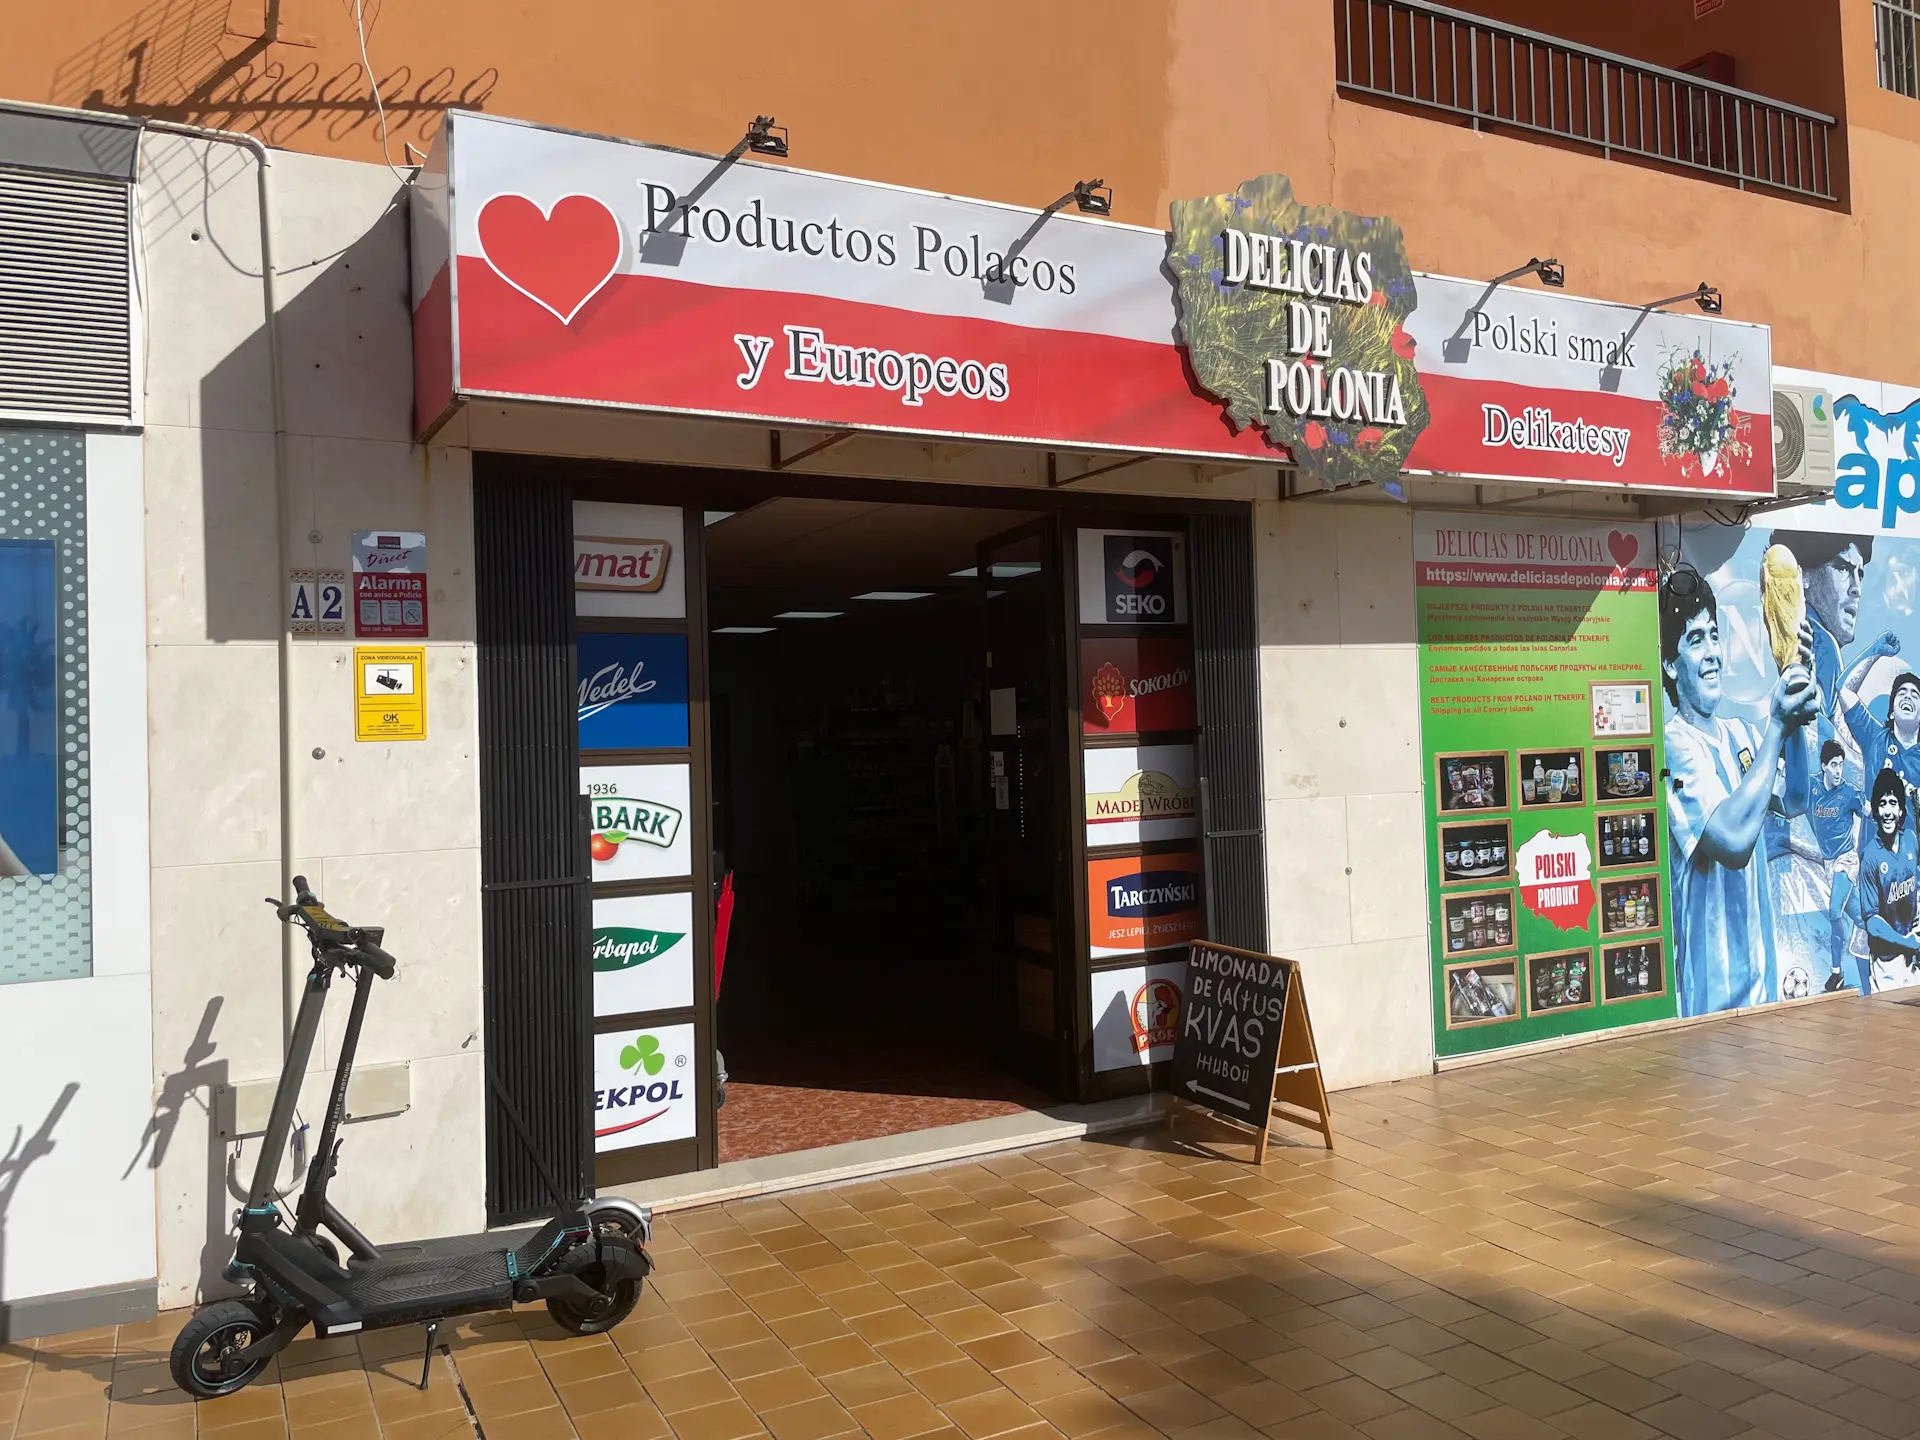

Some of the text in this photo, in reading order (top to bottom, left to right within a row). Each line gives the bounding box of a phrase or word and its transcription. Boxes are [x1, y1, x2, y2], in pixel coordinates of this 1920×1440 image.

[641, 181, 1078, 295] Productos Polacos
[1224, 229, 1373, 305] DELICIAS
[1290, 301, 1333, 360] DE
[1472, 310, 1637, 369] Polski smak
[737, 328, 1007, 405] y Europeos
[1268, 359, 1407, 426] POLONIA
[1483, 406, 1631, 466] Delikatesy
[1436, 529, 1604, 562] DELICIAS DE POLONIA
[366, 550, 412, 567] Direct
[360, 575, 422, 590] Alarma
[1426, 566, 1649, 588] https://www.deliciasdepolonia.com
[1115, 594, 1166, 615] SEKO
[1427, 602, 1469, 611] NAJLEPSZE
[1470, 602, 1509, 611] PRODUKTY
[1511, 604, 1517, 612] Z
[1573, 616, 1611, 624] Kanaryjskie
[1444, 634, 1479, 642] MEJORES
[1481, 634, 1524, 642] PRODUCTOS
[1525, 634, 1535, 642] DE
[1537, 634, 1566, 642] POLONIA
[1464, 645, 1491, 653] pedidos
[1429, 665, 1457, 673] САМЫЕ
[1460, 664, 1518, 673] КАЧЕСТВЕННЫЕ
[1520, 664, 1558, 672] ПОЛЬСКИЕ
[1560, 664, 1597, 672] ПРОДУКТЫ
[1430, 676, 1464, 684] Доставка
[1477, 675, 1515, 683] Канарские
[1430, 696, 1450, 704] BEST
[1452, 695, 1491, 703] PRODUCTS
[1493, 695, 1512, 703] FROM
[1554, 693, 1586, 701] TENERIFE
[383, 713, 399, 722] OK
[1431, 707, 1462, 715] Shipping
[1483, 705, 1508, 713] Canary
[586, 783, 617, 795] 1936
[1096, 799, 1145, 815] MADEJ
[1814, 806, 1839, 817] Mars
[591, 805, 670, 838] BARK
[1535, 851, 1576, 880] POLSKI
[1110, 882, 1195, 910] TARCZYŃSKI
[1537, 884, 1579, 909] PRODUKT
[1887, 876, 1916, 904] Mars
[1108, 928, 1125, 939] JESZ
[593, 935, 659, 965] rbapol
[1193, 975, 1213, 998] DE
[1184, 1001, 1264, 1059] KVAS
[329, 1062, 352, 1133] THE BEST OR NOTHING
